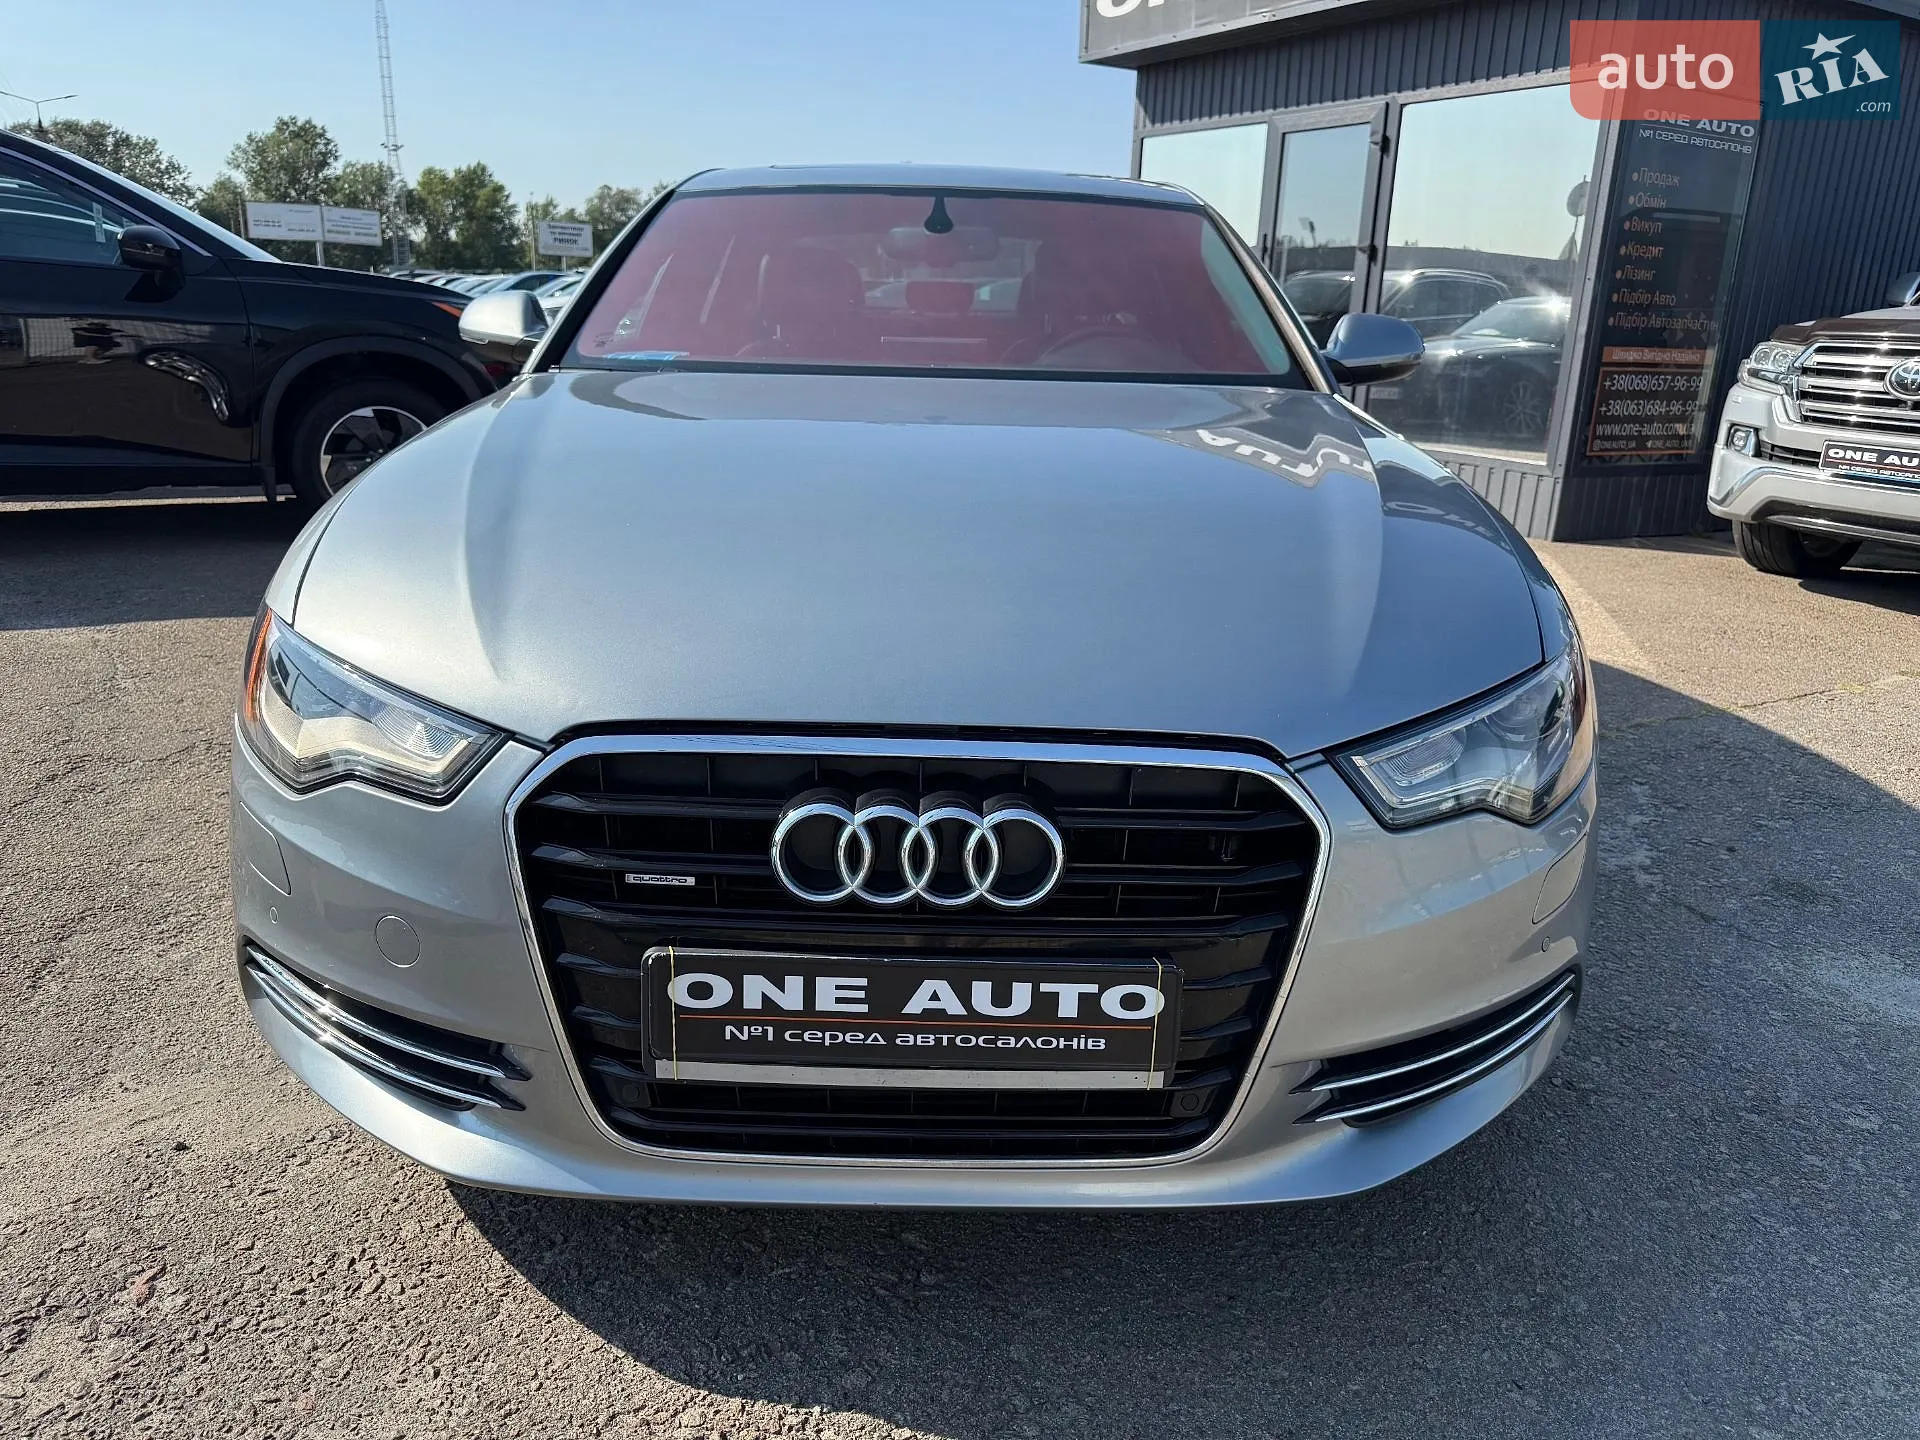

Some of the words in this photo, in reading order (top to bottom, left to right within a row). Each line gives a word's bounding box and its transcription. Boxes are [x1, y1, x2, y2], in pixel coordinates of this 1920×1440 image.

[1643, 108, 1692, 127] ONE
[1696, 119, 1755, 137] AUTO
[1638, 168, 1681, 187] Продаж
[1635, 192, 1667, 209] Обмін
[1631, 217, 1662, 237] Викуп
[1626, 244, 1664, 260] Кредит
[1622, 264, 1656, 281] Лізинг
[1618, 288, 1651, 307] Підбір
[1652, 290, 1677, 306] Авто
[1615, 312, 1648, 331] Підбір
[1603, 374, 1703, 392] +38(068)657-96-99
[1828, 448, 1878, 462] ONE
[632, 876, 688, 884] quattro
[667, 972, 869, 1012] ONE
[901, 979, 1165, 1020] AUTO
[724, 1024, 773, 1042] №1
[784, 1029, 887, 1048] серед
[895, 1032, 1106, 1050] автосалонів
